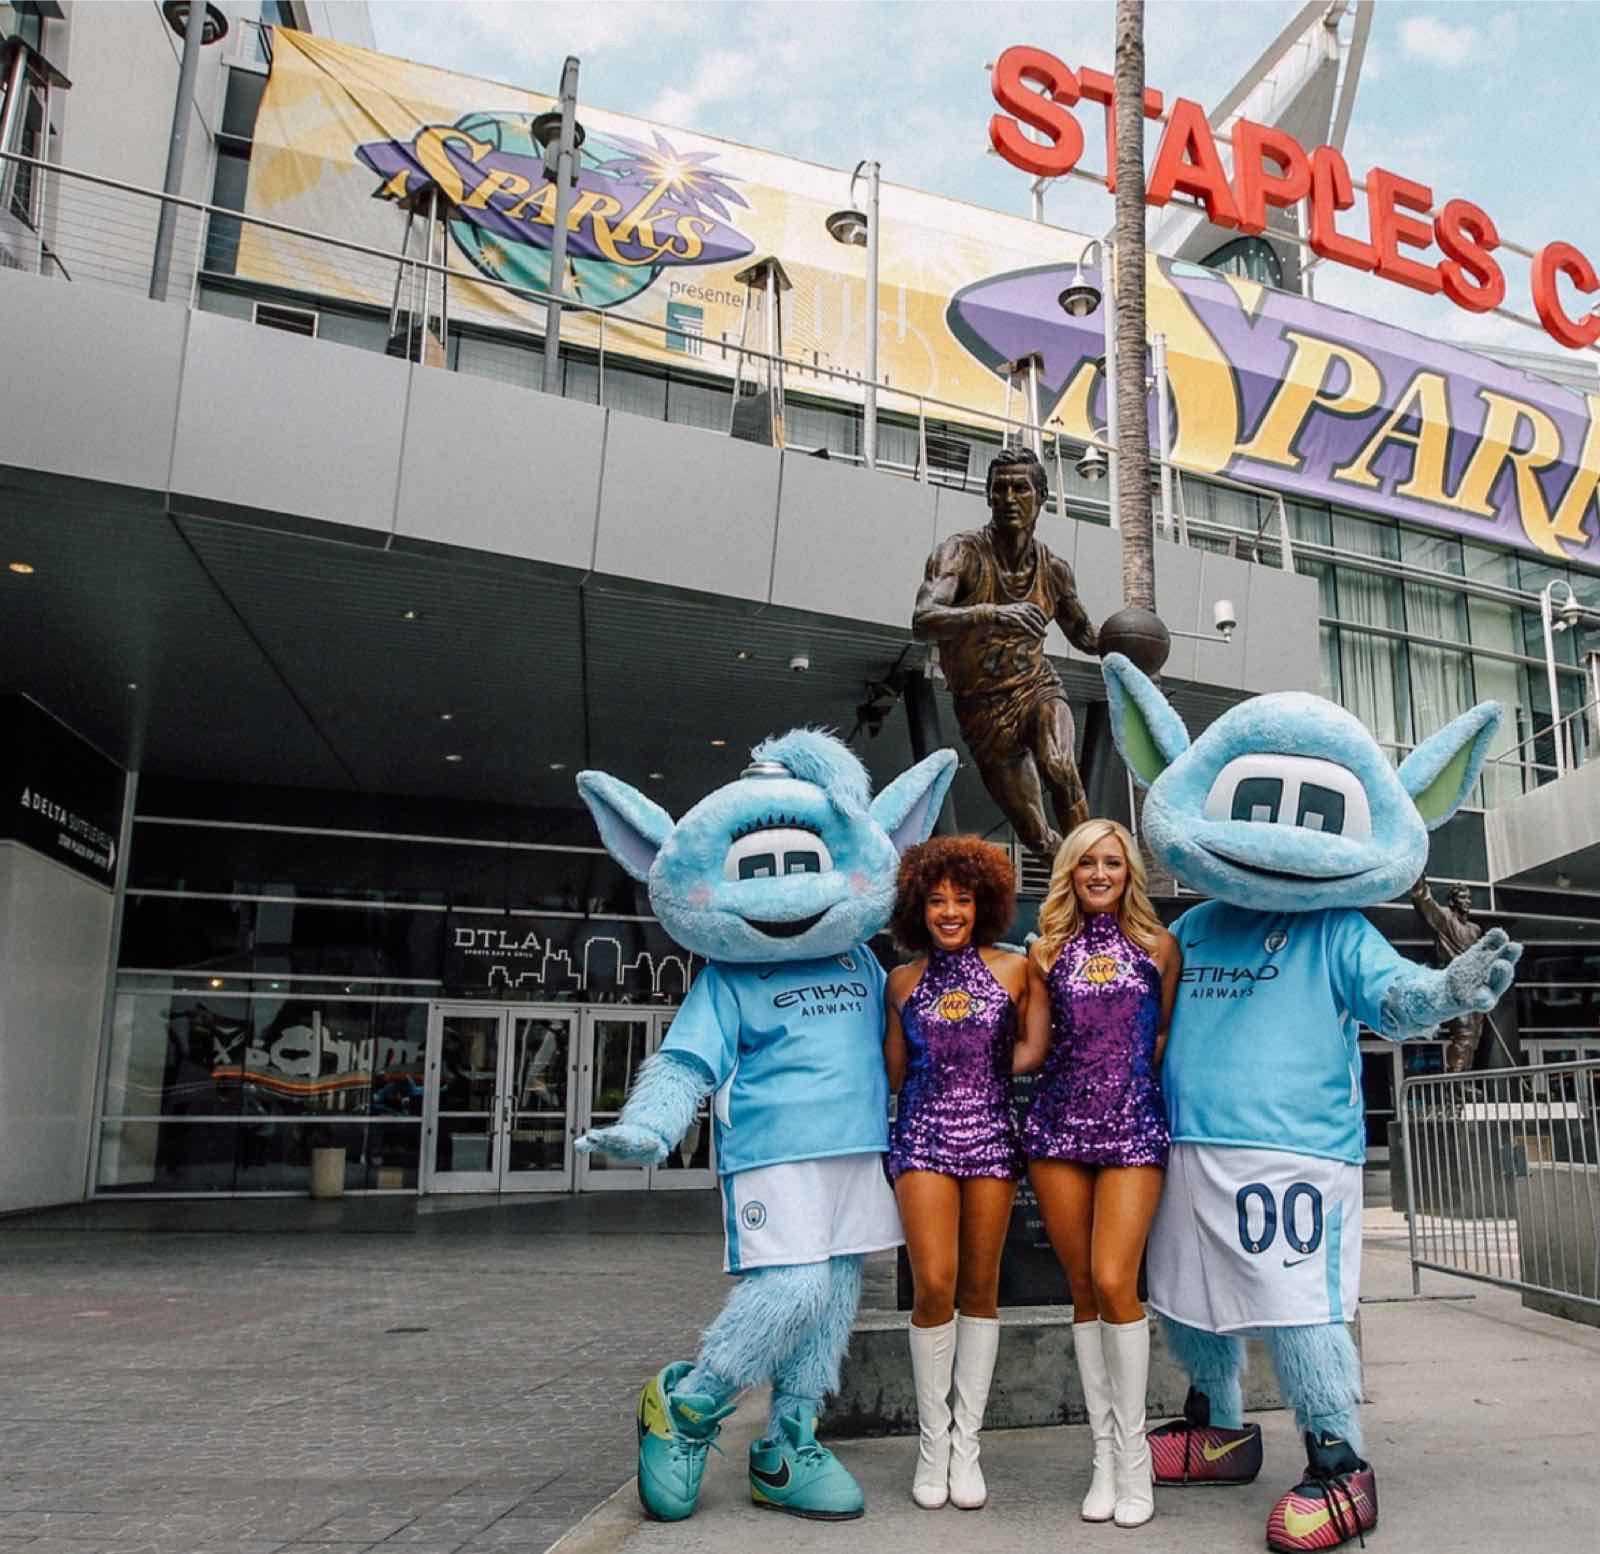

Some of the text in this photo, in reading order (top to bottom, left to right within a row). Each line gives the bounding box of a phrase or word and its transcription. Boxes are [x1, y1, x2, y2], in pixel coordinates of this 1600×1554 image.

[989, 45, 1506, 314] STAPLES
[383, 125, 714, 267] SPARKS
[32, 792, 67, 826] DELTA
[454, 927, 541, 951] DTLA
[1180, 965, 1280, 983] ETIHAD
[773, 982, 868, 1008] ETIHAD
[1190, 987, 1255, 1000] AIRWAYS
[801, 1001, 863, 1017] AIRWAYS
[1236, 1182, 1324, 1255] 00
